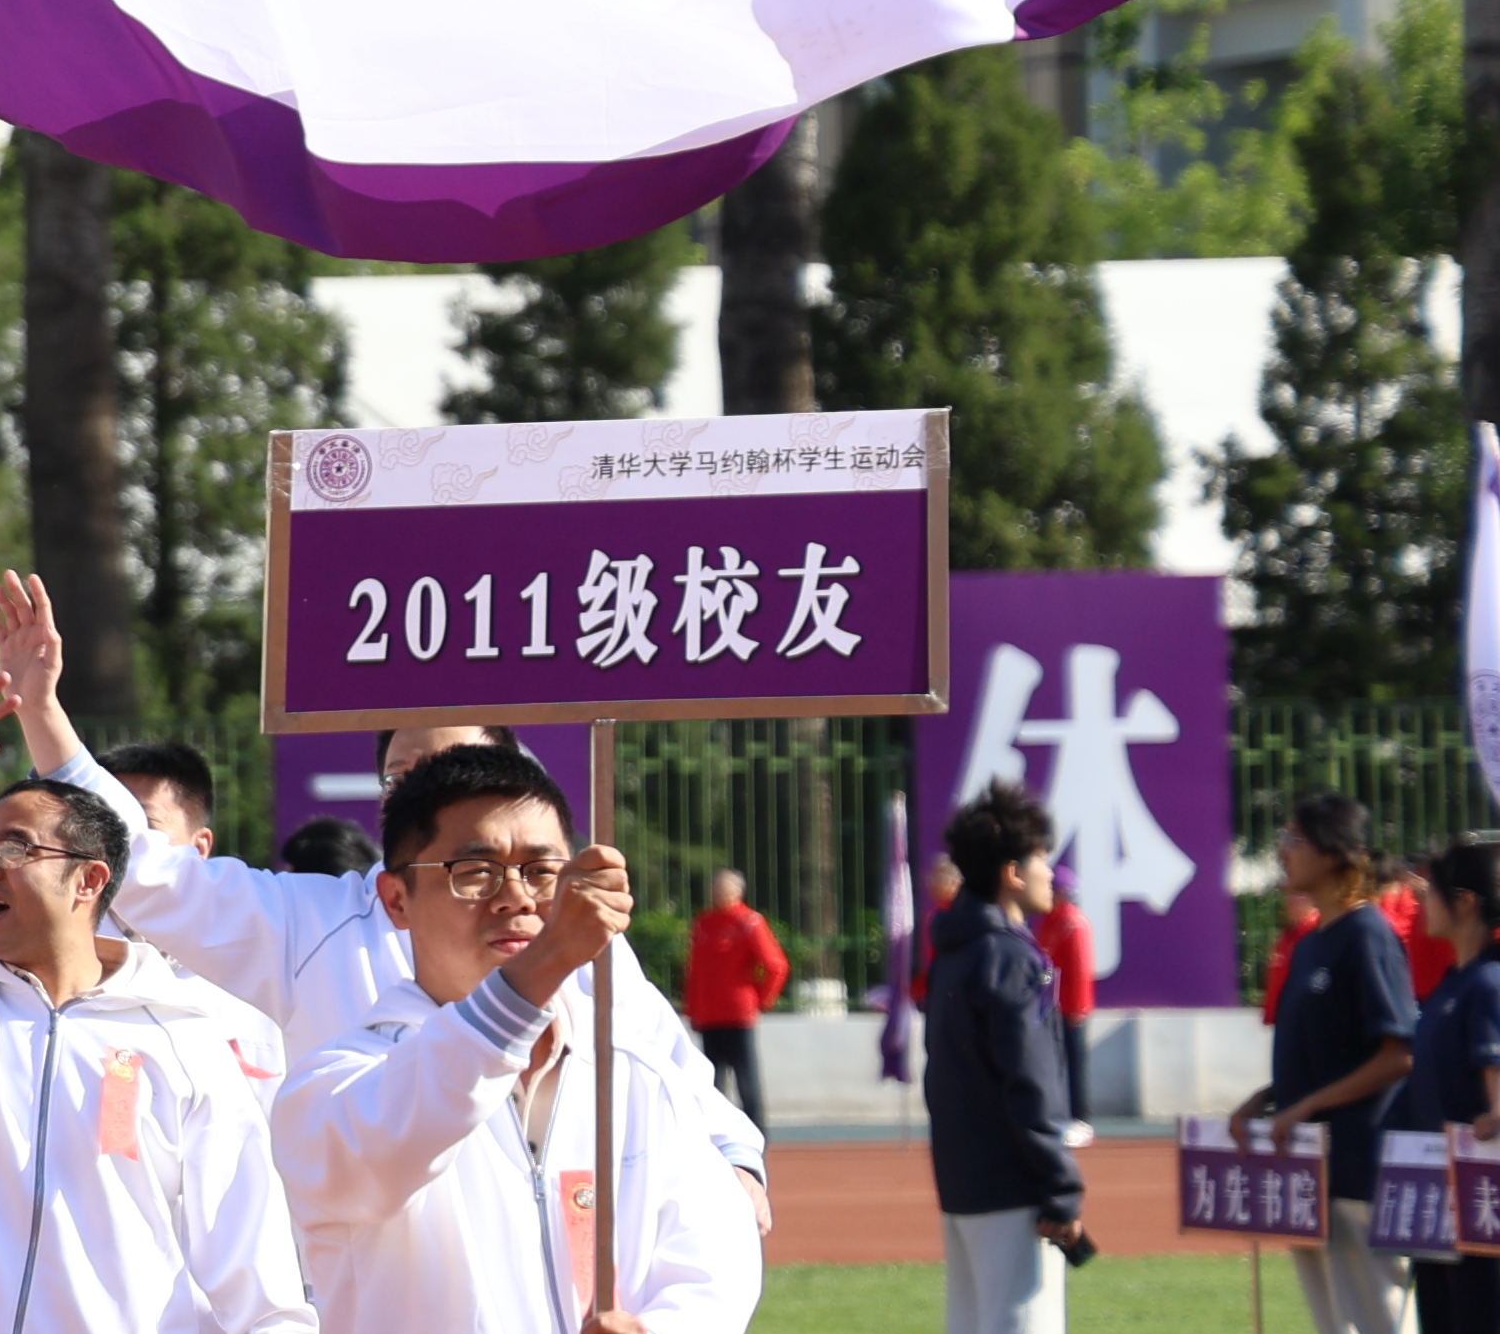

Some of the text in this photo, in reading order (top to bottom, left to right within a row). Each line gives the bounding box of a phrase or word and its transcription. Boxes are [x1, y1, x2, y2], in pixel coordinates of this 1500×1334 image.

[590, 443, 926, 480] 清华大学马约翰杯学生运动会
[346, 542, 862, 667] 2011级校友
[1192, 1164, 1317, 1230] 为先书院
